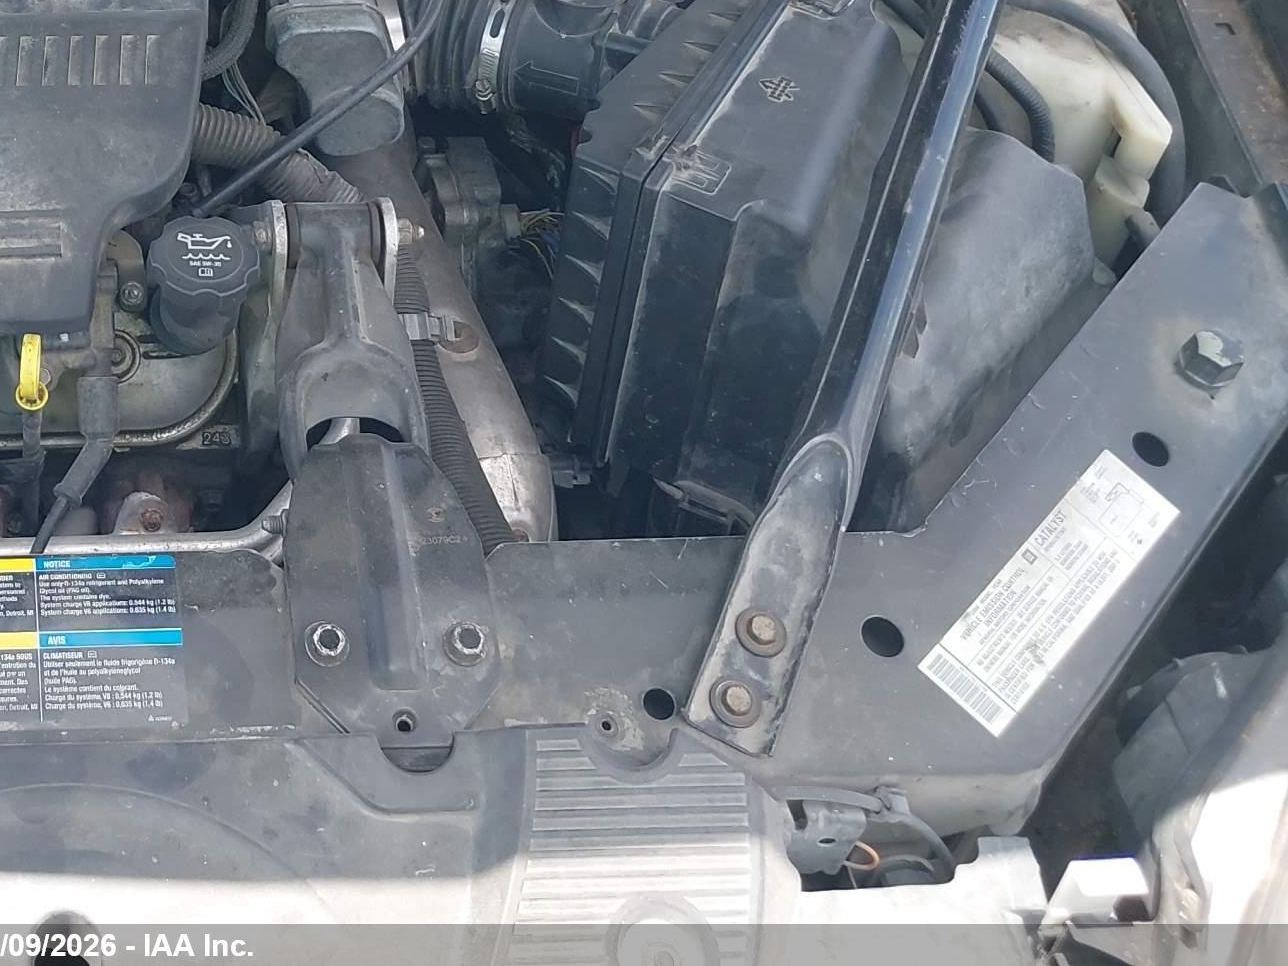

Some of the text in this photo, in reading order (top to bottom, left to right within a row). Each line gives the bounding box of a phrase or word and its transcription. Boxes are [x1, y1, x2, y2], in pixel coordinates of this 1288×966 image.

[1033, 509, 1066, 547] CATALYST
[44, 560, 70, 568] NOTICE
[960, 615, 982, 640] VEHICLE
[980, 590, 1003, 617] EMISSION
[984, 589, 1016, 626] INFORMATION
[48, 636, 66, 644] AVIS
[46, 702, 66, 710] Charge
[134, 700, 141, 708] kg
